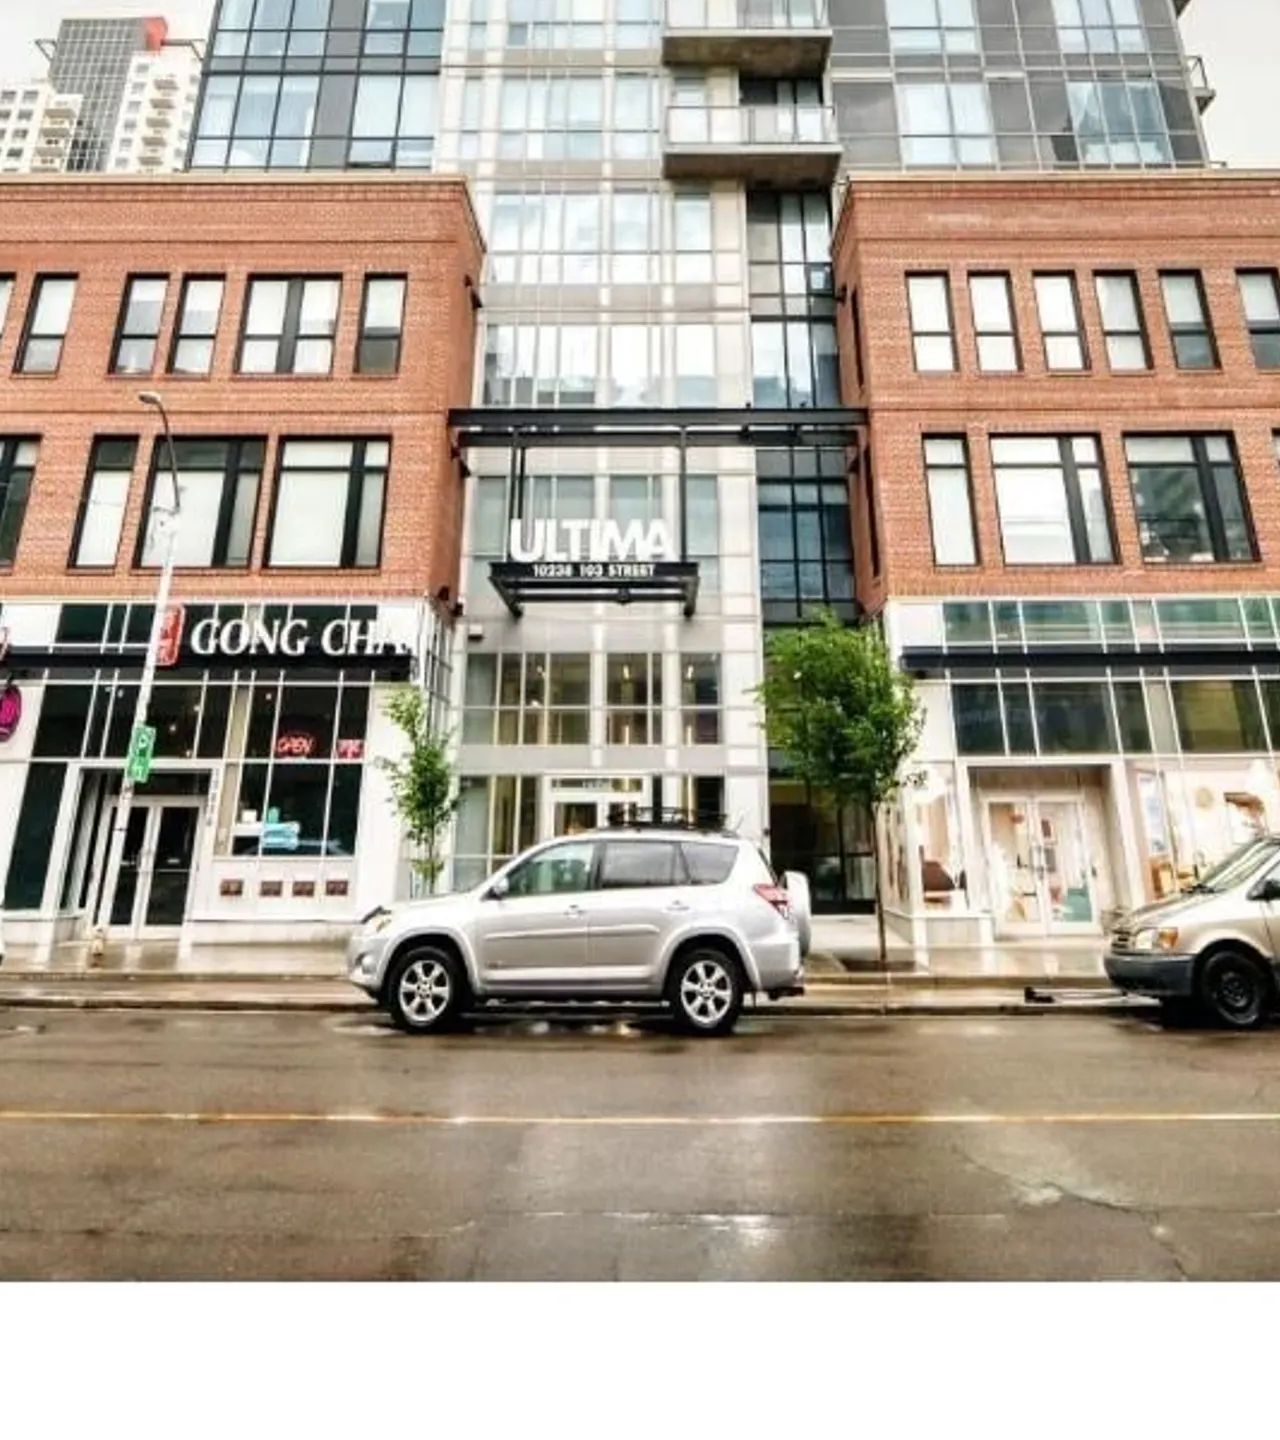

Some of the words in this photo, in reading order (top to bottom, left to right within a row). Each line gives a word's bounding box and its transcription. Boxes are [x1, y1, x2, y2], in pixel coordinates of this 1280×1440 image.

[510, 518, 678, 562] ULTIMA
[580, 564, 603, 577] 103
[608, 564, 656, 577] STREET
[190, 618, 310, 656] GONG
